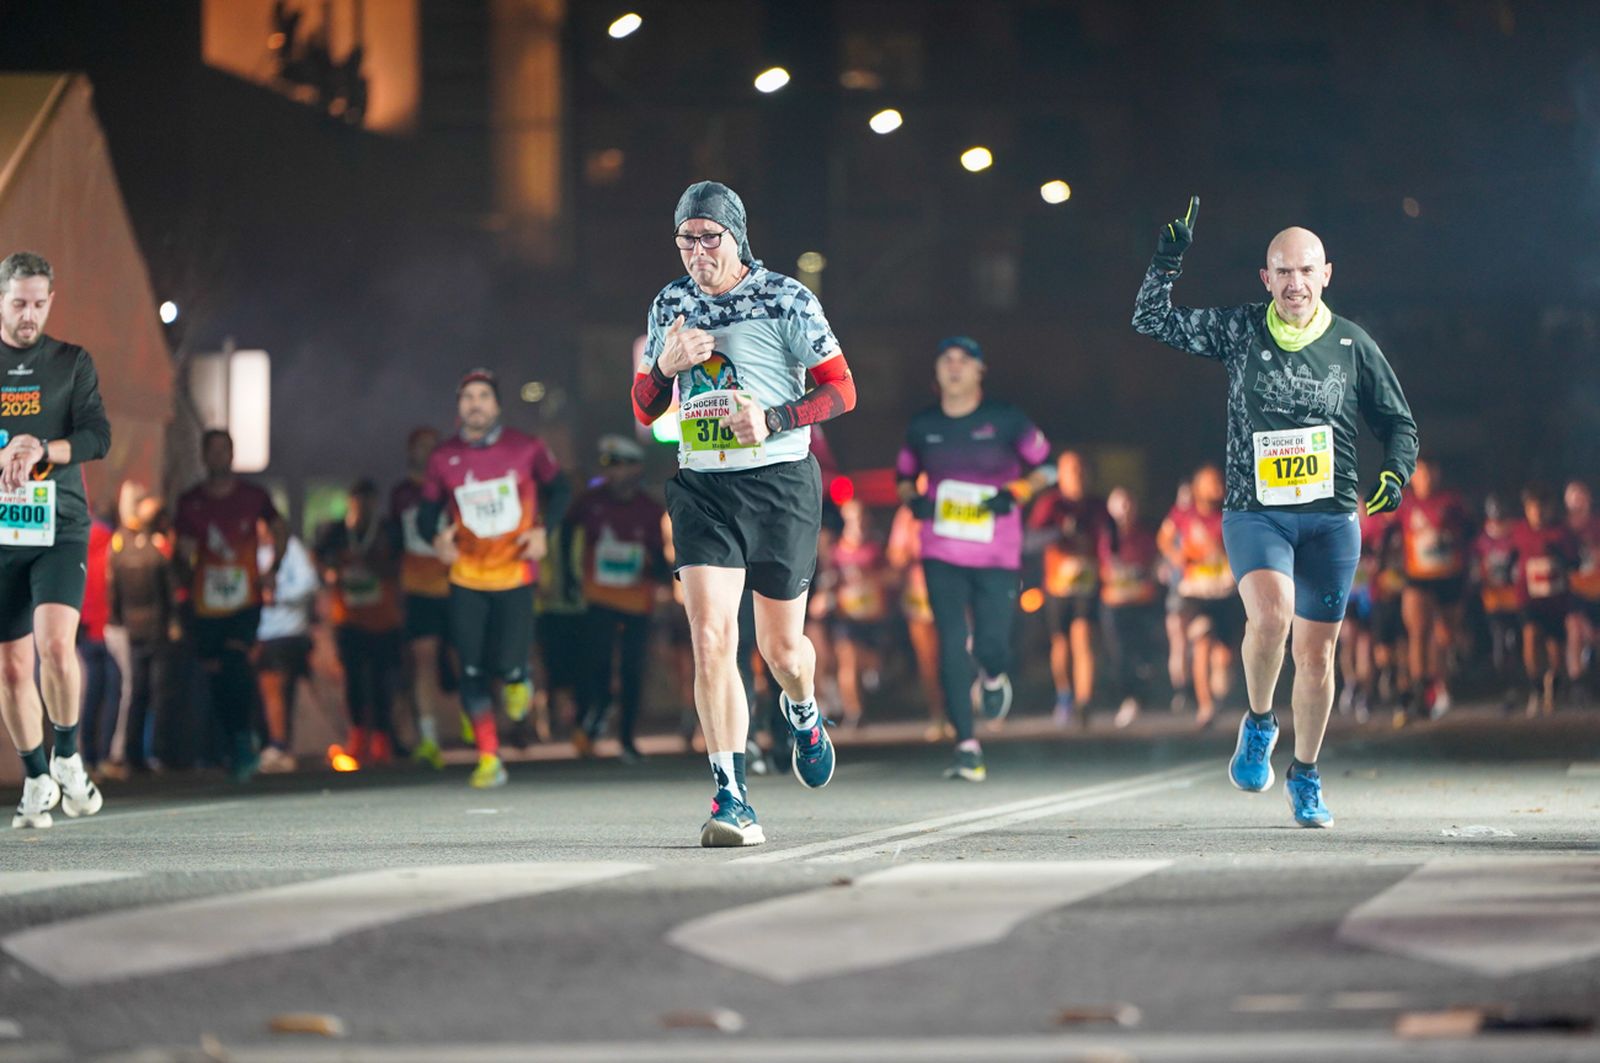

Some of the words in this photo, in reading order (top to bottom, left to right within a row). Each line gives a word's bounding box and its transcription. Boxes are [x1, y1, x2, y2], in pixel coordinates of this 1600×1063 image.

[1, 391, 41, 402] FONDO
[1, 400, 41, 416] 2025
[693, 401, 718, 409] NOCHE
[720, 399, 728, 407] DE
[685, 411, 701, 419] SAN
[1264, 449, 1278, 457] SAN
[1273, 455, 1318, 479] 1720
[0, 504, 45, 524] 2600
